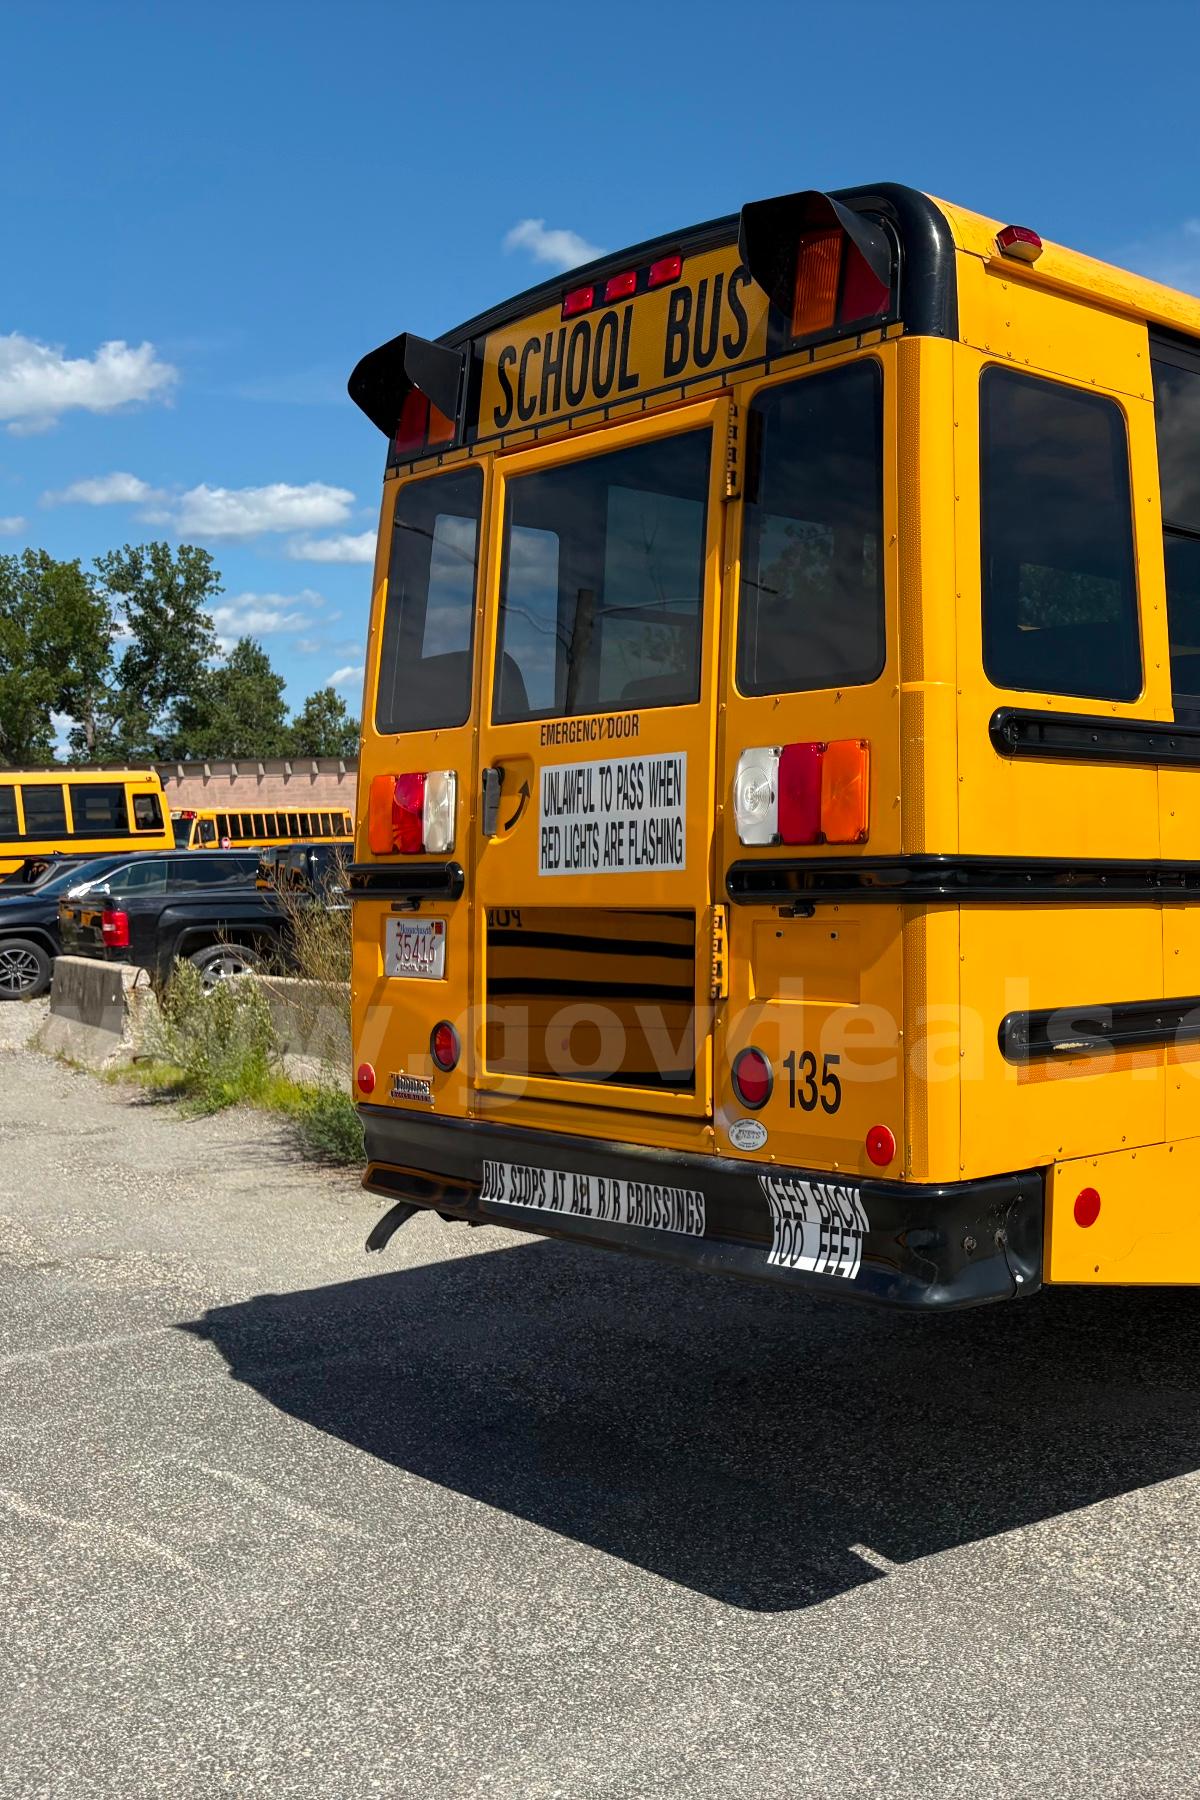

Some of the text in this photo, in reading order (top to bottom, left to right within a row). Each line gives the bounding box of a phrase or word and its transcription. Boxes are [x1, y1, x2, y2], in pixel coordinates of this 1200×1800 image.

[494, 265, 752, 428] SCHOOL BUS
[540, 714, 640, 746] EMERGENCY DOOR
[544, 759, 682, 817] UNLAWFUL TO PASS WHEN
[541, 816, 683, 869] RED LIGHTS ARE FLASHING
[396, 933, 435, 963] 35416
[783, 1050, 842, 1115] 135
[484, 1162, 704, 1235] BUS STOPS AT ALL R/R CROSSINGS
[758, 1175, 867, 1231] KEEP BACK
[772, 1219, 863, 1278] 100 FEET
